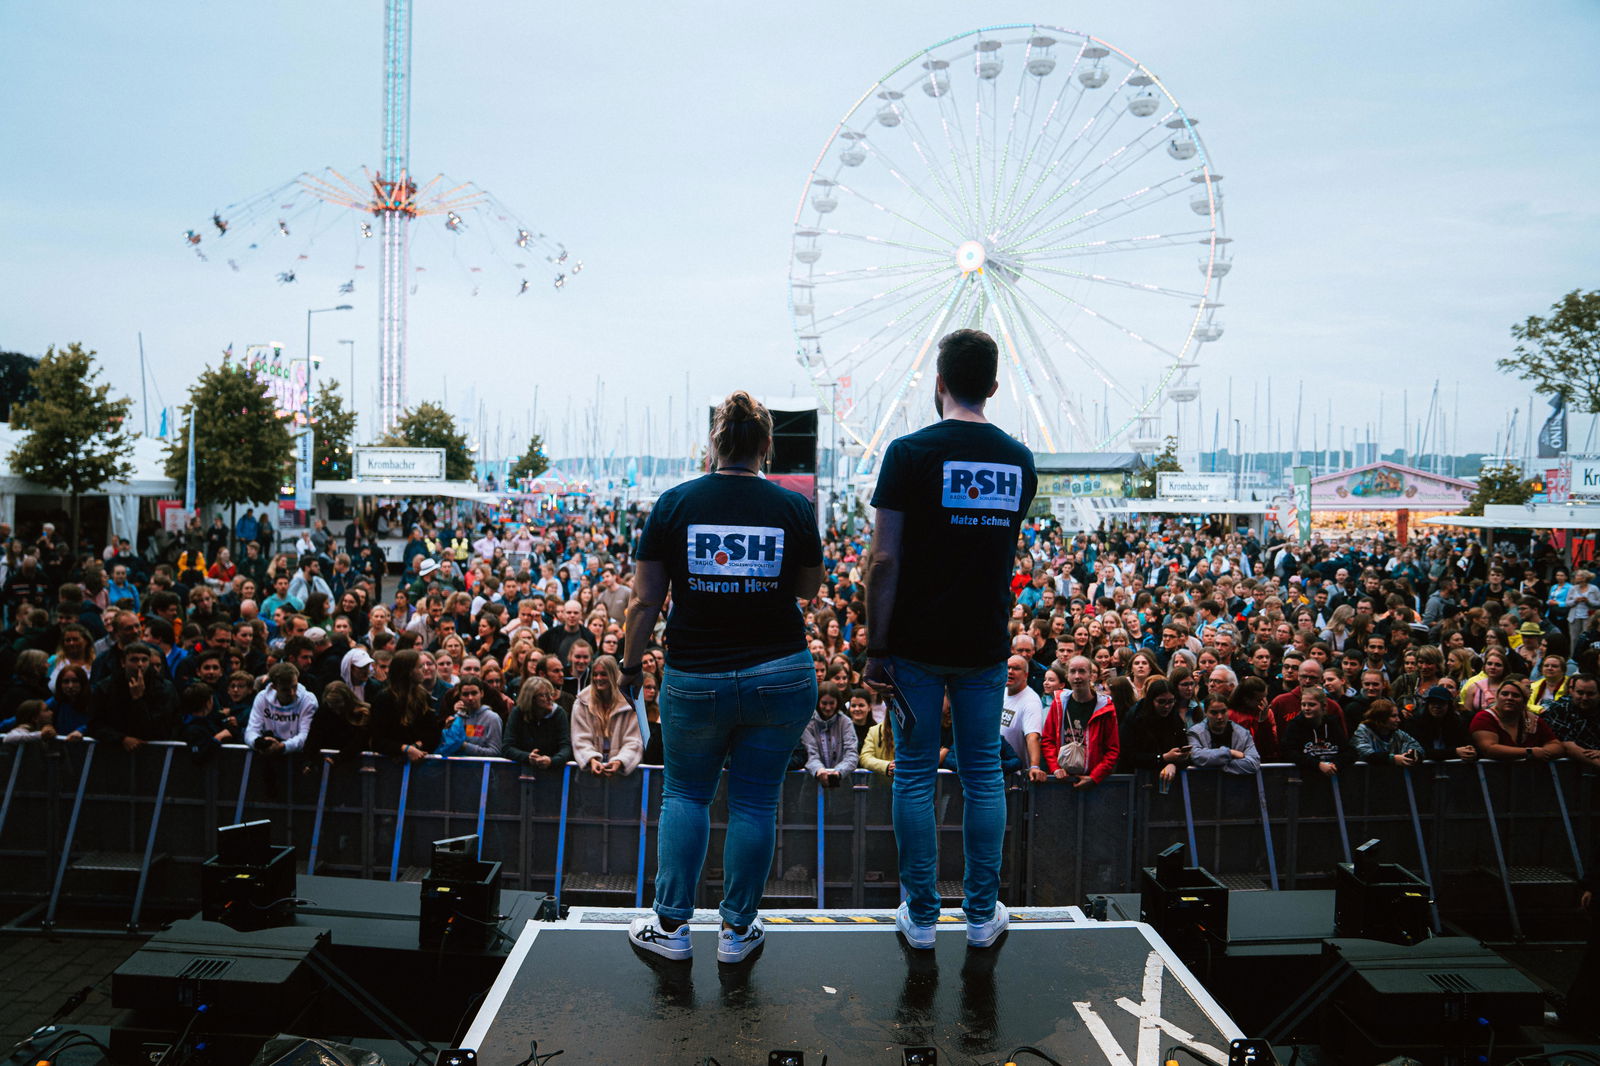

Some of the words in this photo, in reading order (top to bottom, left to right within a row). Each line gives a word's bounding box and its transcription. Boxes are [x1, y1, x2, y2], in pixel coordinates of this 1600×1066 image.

[367, 458, 416, 470] Krombacher
[950, 469, 1018, 497] RSH
[1583, 468, 1600, 486] Kr
[1168, 481, 1210, 491] Krombacher
[950, 514, 978, 525] Matze
[695, 532, 777, 561] RSH
[687, 577, 740, 593] Sharon
